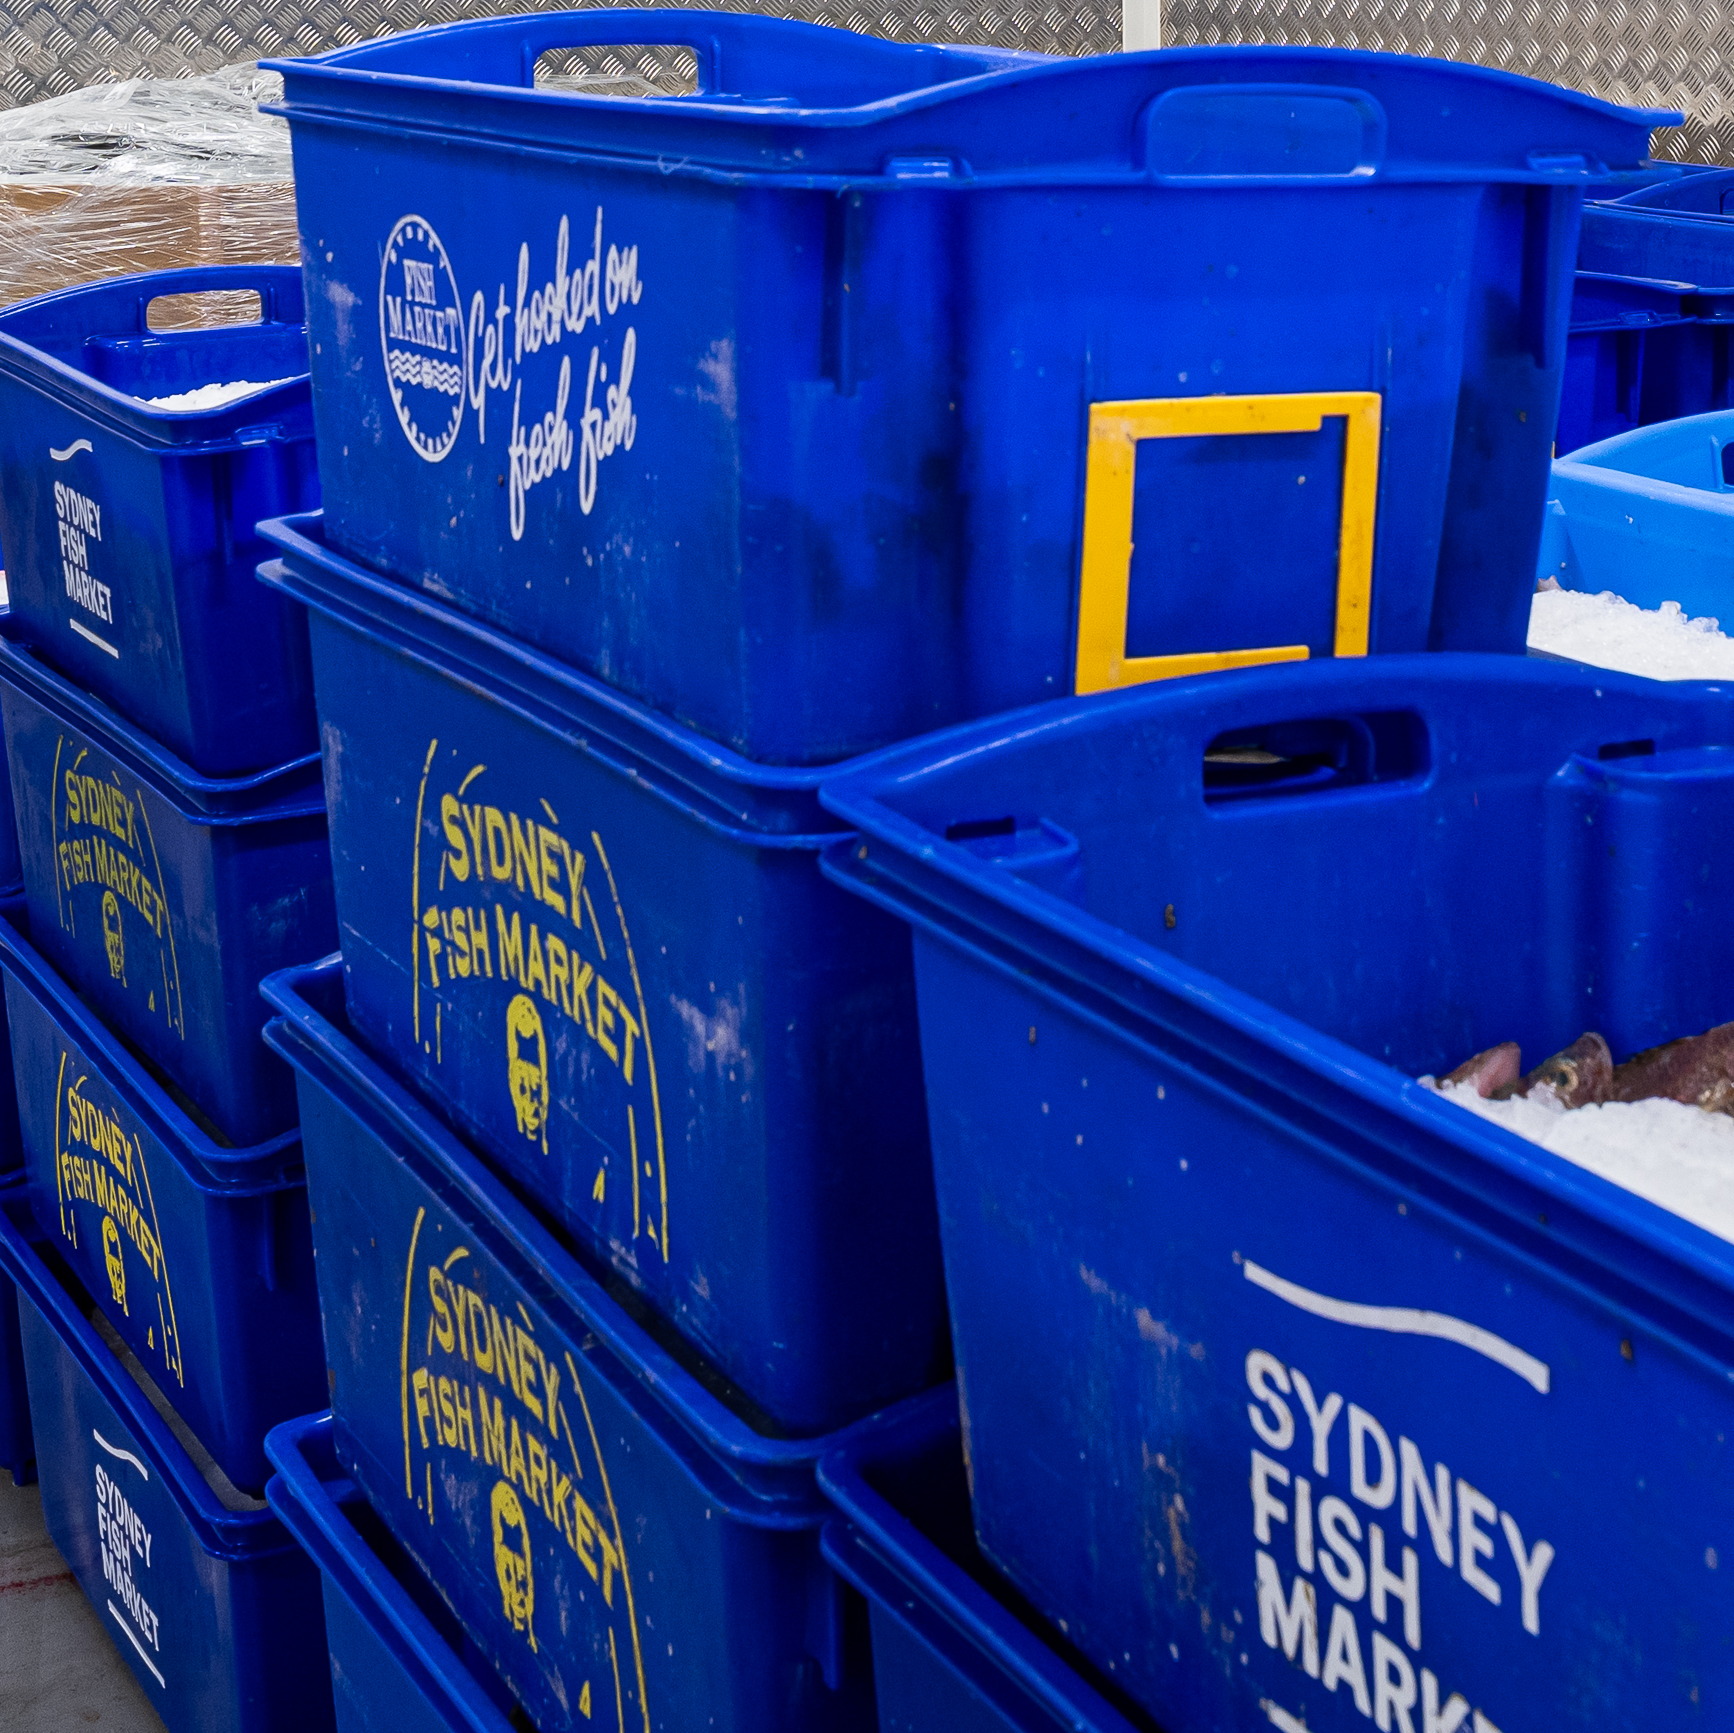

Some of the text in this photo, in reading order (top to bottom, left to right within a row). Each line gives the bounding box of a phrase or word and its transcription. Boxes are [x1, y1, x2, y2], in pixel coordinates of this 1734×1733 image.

[385, 294, 459, 354] MARKET
[402, 258, 437, 306] FISH
[467, 205, 643, 445] Get hooked on
[508, 326, 638, 541] fresh fish
[54, 480, 102, 542] SYDNEY
[58, 520, 89, 570] FISH
[63, 560, 113, 625] MARKET
[65, 769, 135, 849] SYDNEY
[440, 792, 587, 929] SYDNEY
[58, 834, 164, 939] FISH MARKET
[423, 903, 641, 1086] FISH MARKET
[68, 1086, 133, 1187] SYDNEY
[61, 1150, 161, 1283] FISH MARKET
[428, 1265, 561, 1440] SYDNEY
[95, 1464, 152, 1568] SYDNEY
[97, 1501, 132, 1577] FISH
[412, 1367, 623, 1610] FISH MARKET
[1244, 1348, 1556, 1637] SYDNEY
[101, 1541, 160, 1652] MARKET
[1249, 1448, 1422, 1651] FISH
[1254, 1549, 1504, 1733] MARK
